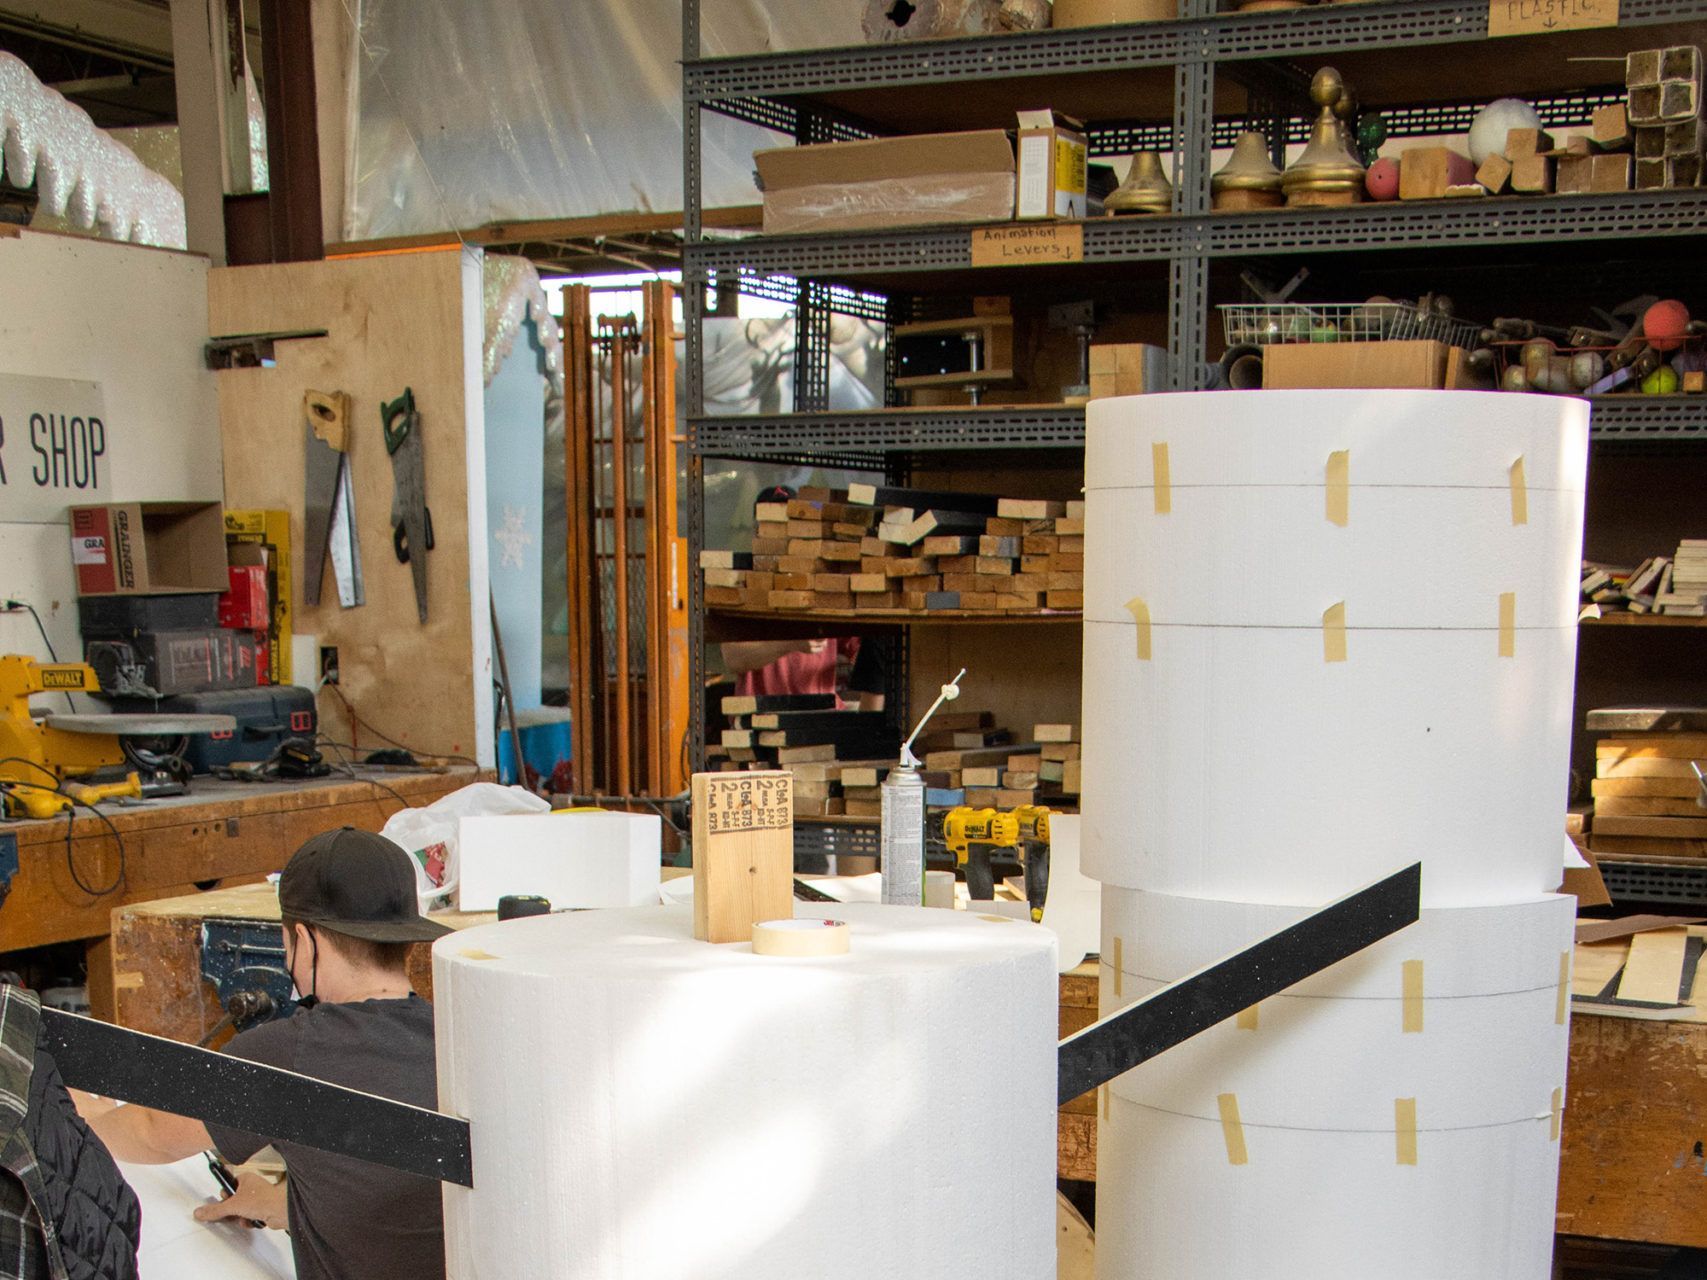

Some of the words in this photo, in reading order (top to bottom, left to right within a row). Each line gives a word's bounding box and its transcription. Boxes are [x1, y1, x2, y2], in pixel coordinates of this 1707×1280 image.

[983, 227, 1056, 241] Animation
[1002, 244, 1060, 257] Levers
[29, 412, 105, 489] SHOP
[117, 510, 135, 589] GRAINGER
[721, 782, 738, 792] 2
[757, 780, 773, 790] 2
[741, 809, 752, 827] 873
[777, 807, 788, 825] 873
